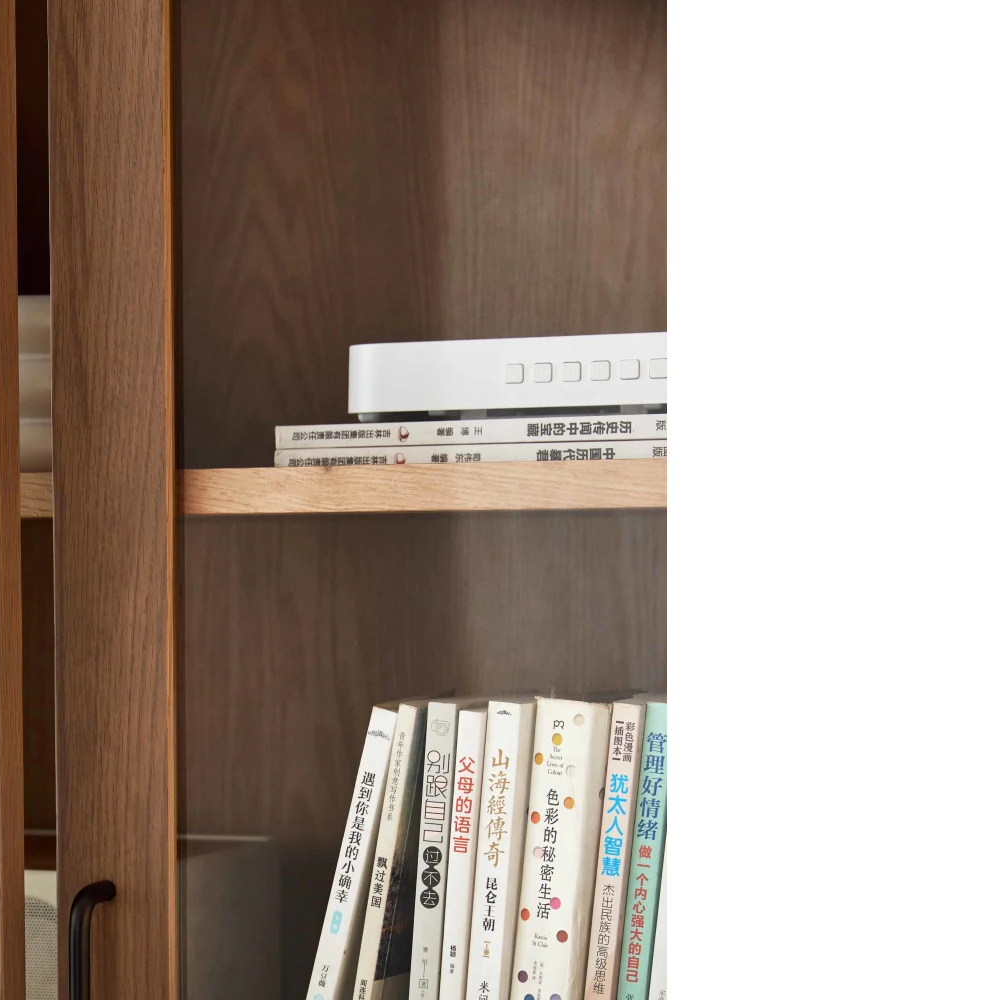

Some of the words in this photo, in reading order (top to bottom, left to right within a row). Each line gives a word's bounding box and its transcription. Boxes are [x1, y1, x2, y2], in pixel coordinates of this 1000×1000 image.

[287, 456, 388, 468] 吉林出版集团有限责任公司
[291, 428, 392, 441] 吉林出版集团有限责任公司
[526, 421, 632, 437] 历史传闻中的宝藏
[536, 447, 616, 462] 中国历代暴君
[386, 731, 407, 822] 青年作家创意写作书系
[546, 760, 559, 768] Lives
[547, 768, 563, 776] Colour
[549, 753, 563, 761] Secret
[622, 721, 635, 763] 彩色漫画
[452, 756, 475, 854] 父母的语言
[483, 748, 511, 868] 山海經傳奇
[636, 731, 668, 841] 管理好情绪
[334, 771, 376, 904] 遇到你是我的小确幸
[420, 750, 451, 908] 别跟自己过不去
[536, 788, 560, 920] 色彩的秘密生活
[601, 773, 629, 877] 犹太人智慧
[370, 856, 388, 909] 飘过美国
[482, 876, 498, 932] 昆仑王朝
[625, 844, 653, 984] 做一个内心强大的自己
[592, 883, 616, 995] 杰出民族的高级思维
